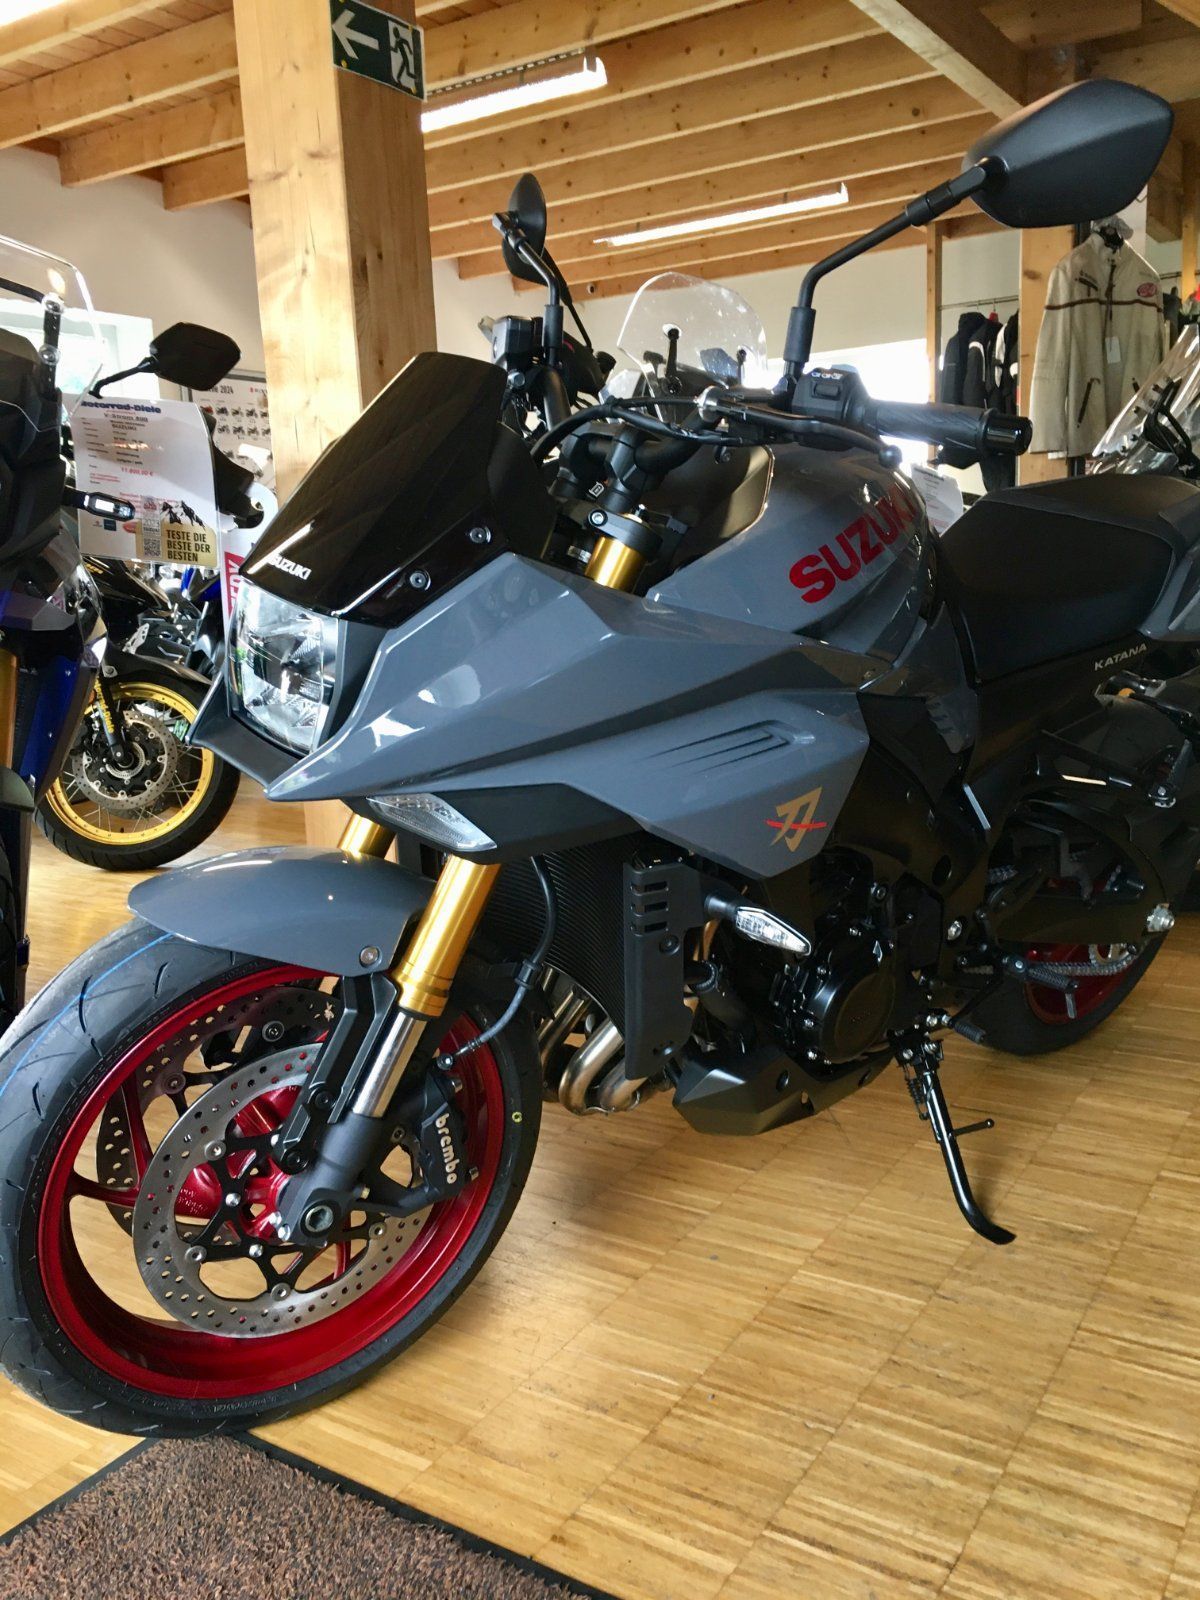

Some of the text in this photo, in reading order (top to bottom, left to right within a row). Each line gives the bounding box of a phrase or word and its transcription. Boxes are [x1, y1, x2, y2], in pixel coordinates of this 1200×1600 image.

[166, 529, 191, 541] TESTE
[193, 532, 207, 543] DIE
[167, 540, 211, 554] BESTE DER
[168, 550, 198, 562] BESTEN
[270, 553, 312, 580] SUZUKI
[1094, 642, 1148, 671] KATANA
[435, 1112, 460, 1184] brembo
